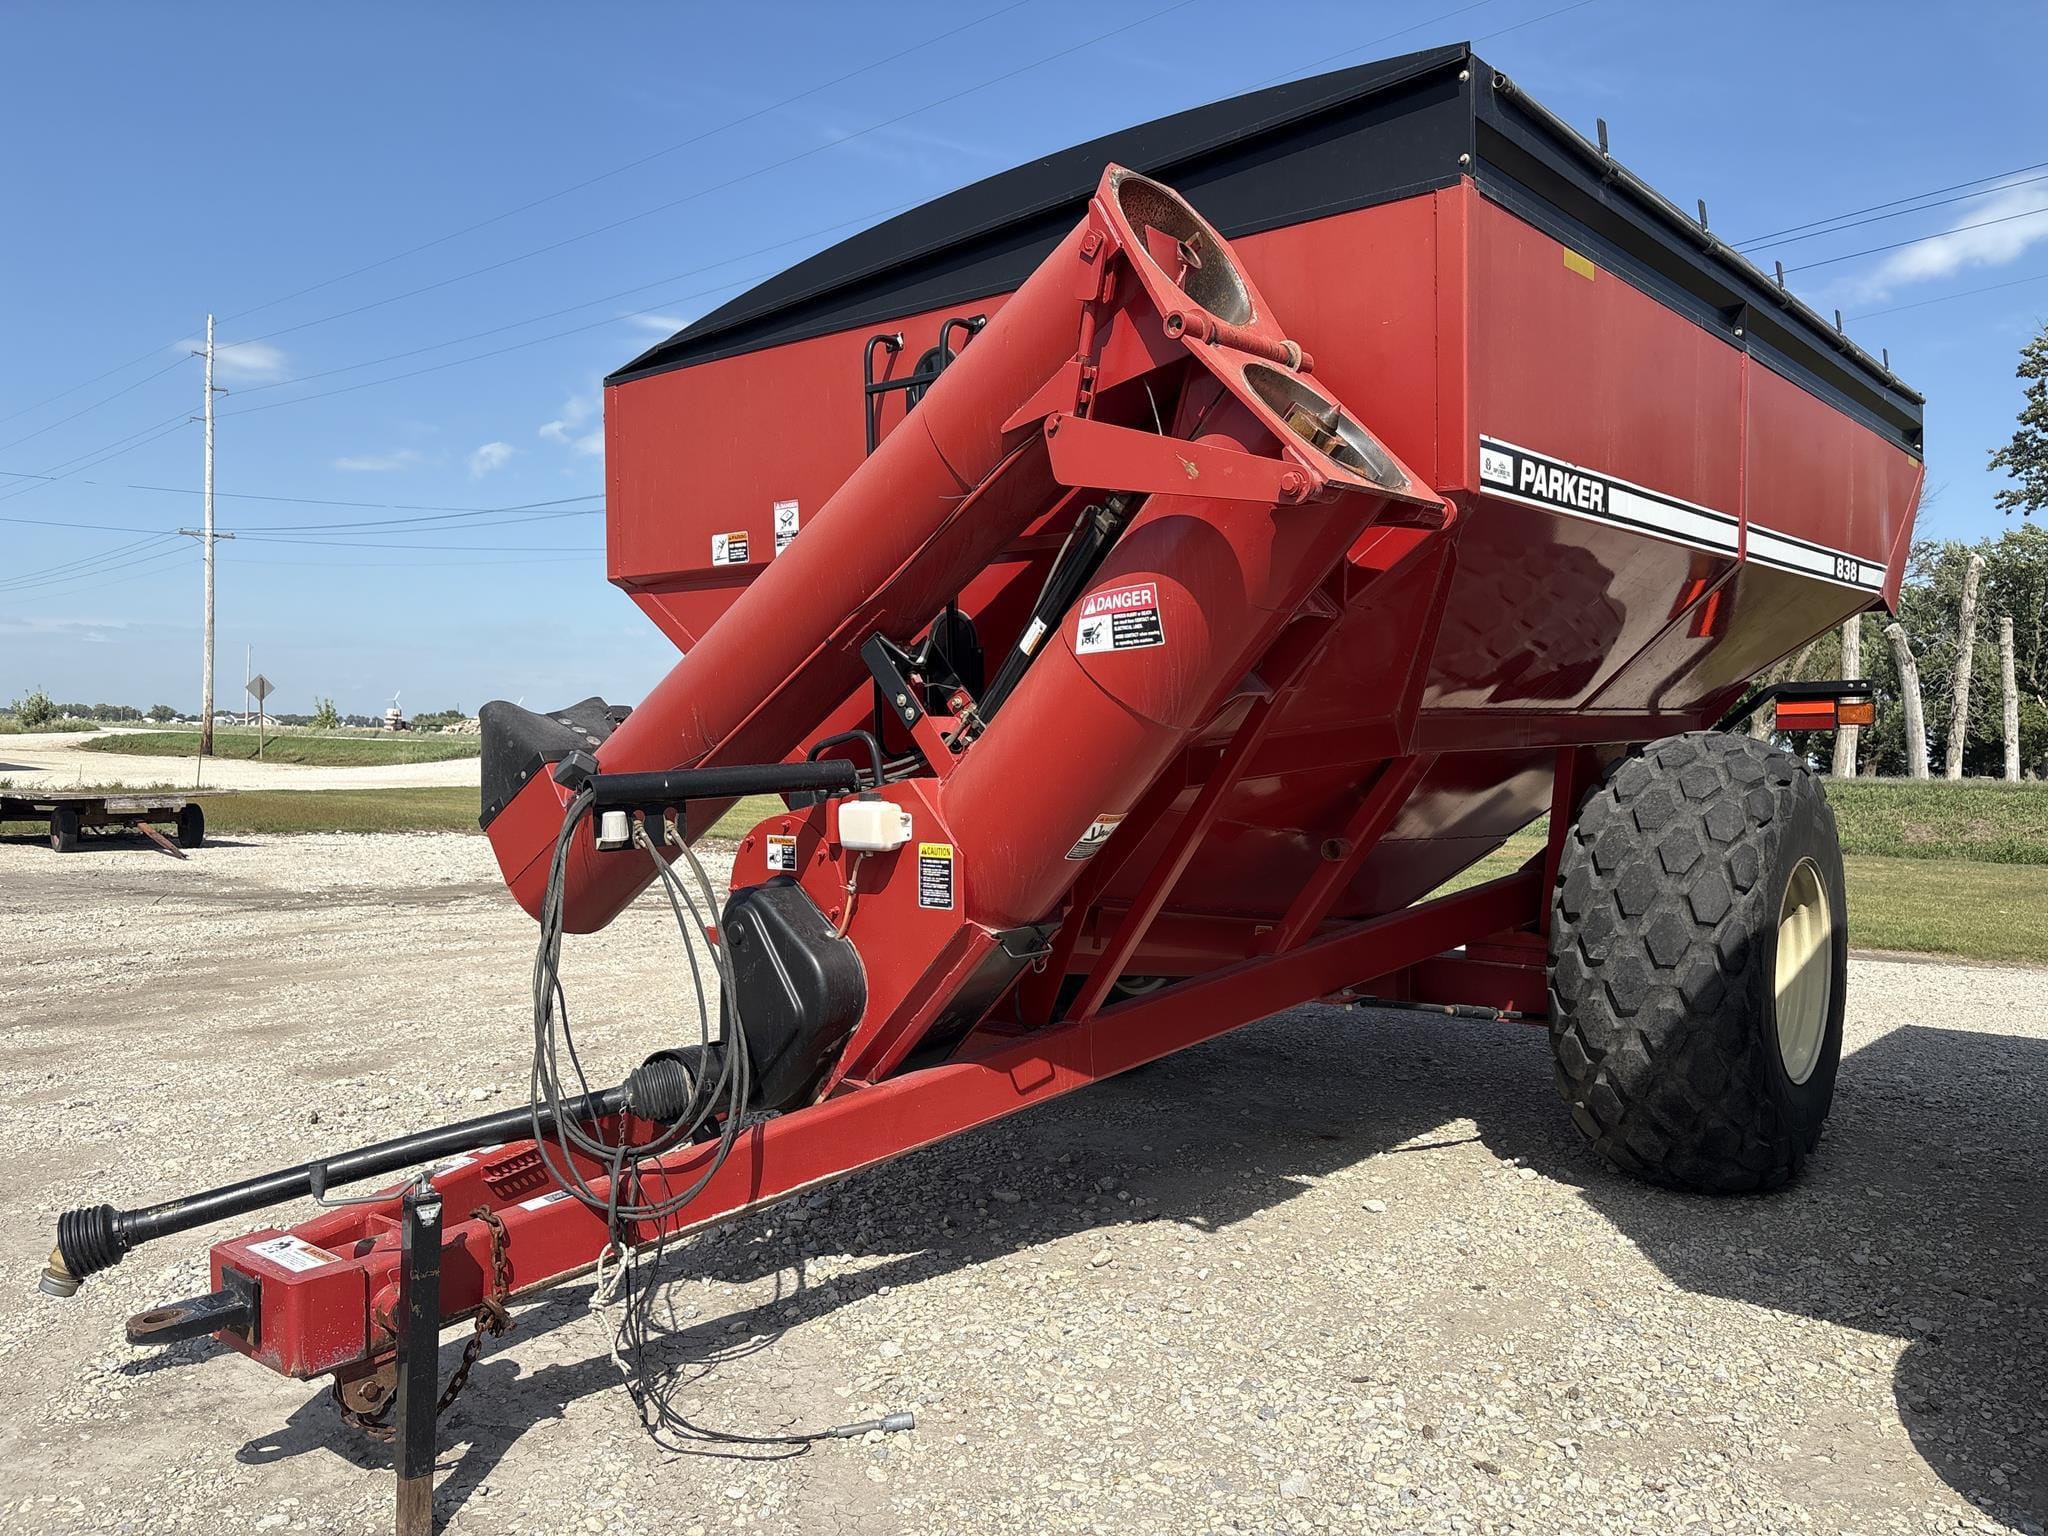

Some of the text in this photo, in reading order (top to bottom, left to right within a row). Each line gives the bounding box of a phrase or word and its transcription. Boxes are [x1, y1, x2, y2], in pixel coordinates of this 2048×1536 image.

[1520, 459, 1604, 512] PARKER
[1836, 557, 1857, 582] 838
[1096, 589, 1152, 611] DANGER
[927, 847, 951, 856] CAUTION
